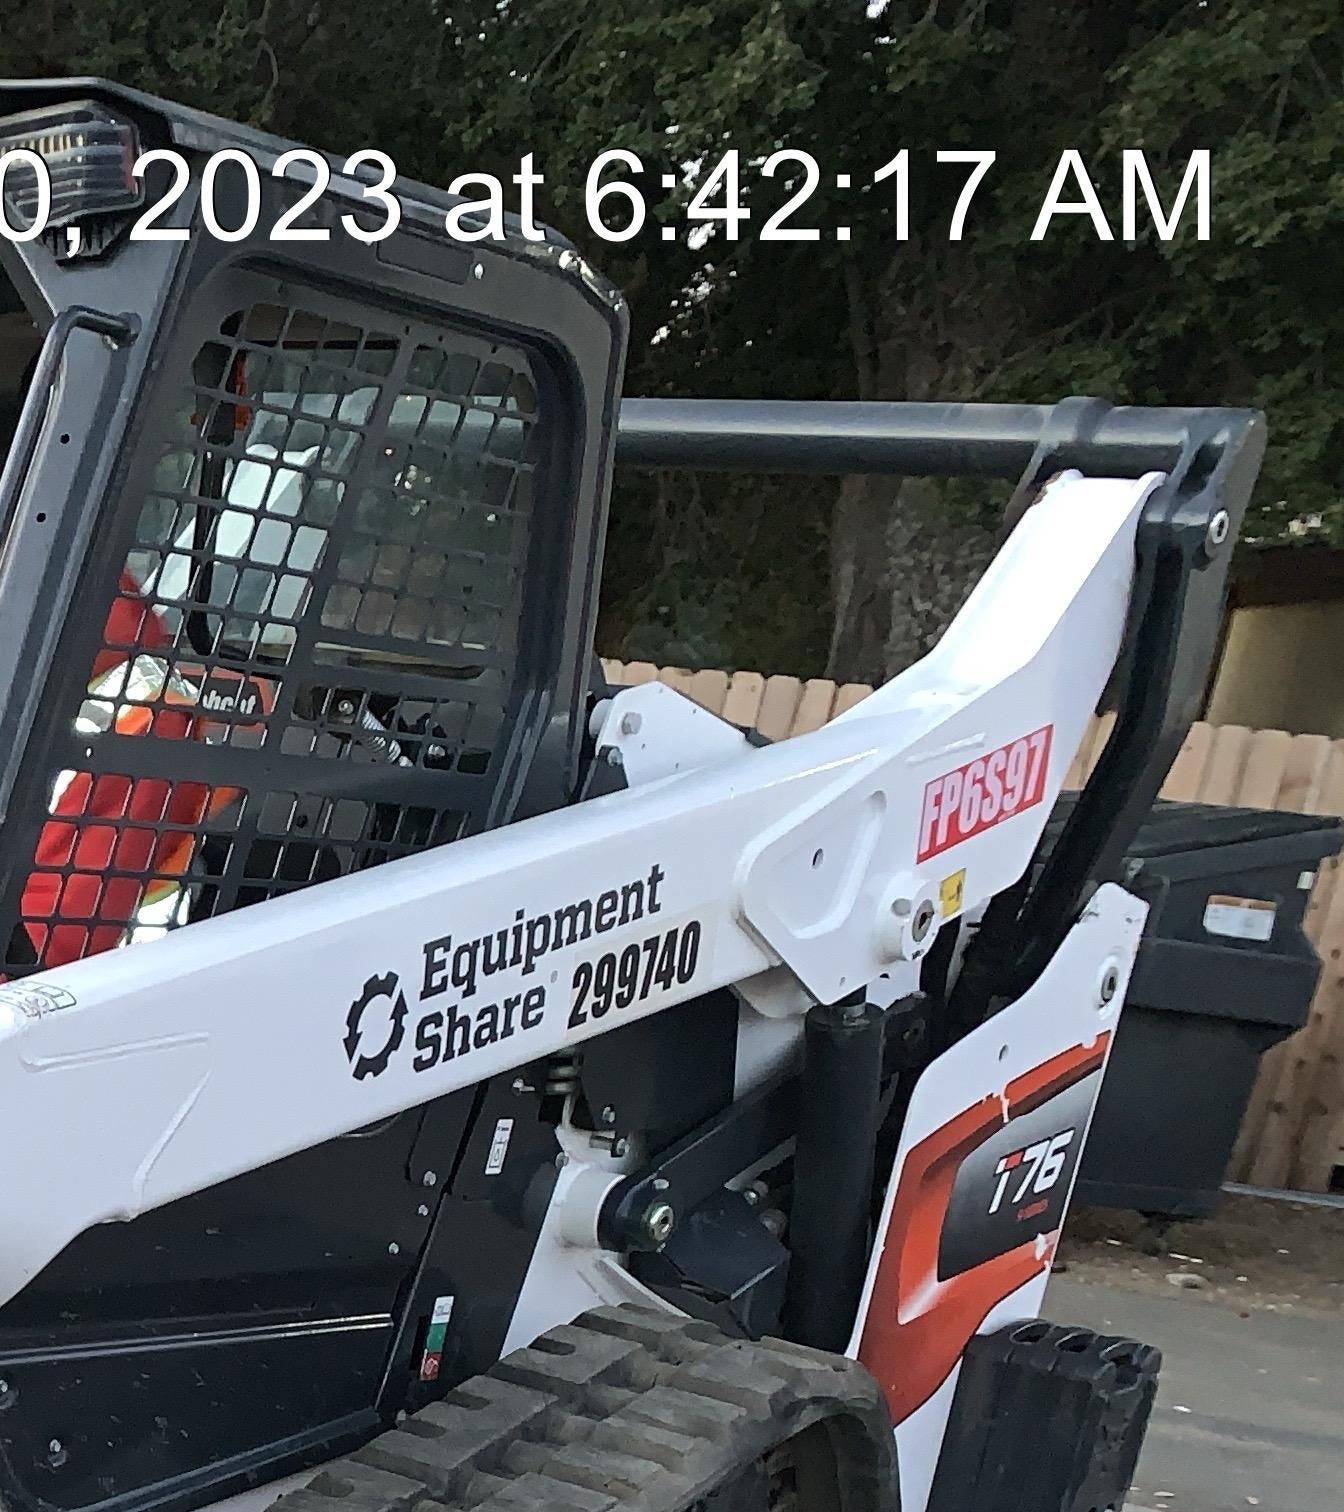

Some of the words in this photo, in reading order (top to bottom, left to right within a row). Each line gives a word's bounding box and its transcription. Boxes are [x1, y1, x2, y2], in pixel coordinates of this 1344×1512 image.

[420, 863, 665, 1001] Equipment
[566, 920, 702, 1030] 299740
[412, 984, 546, 1073] Share
